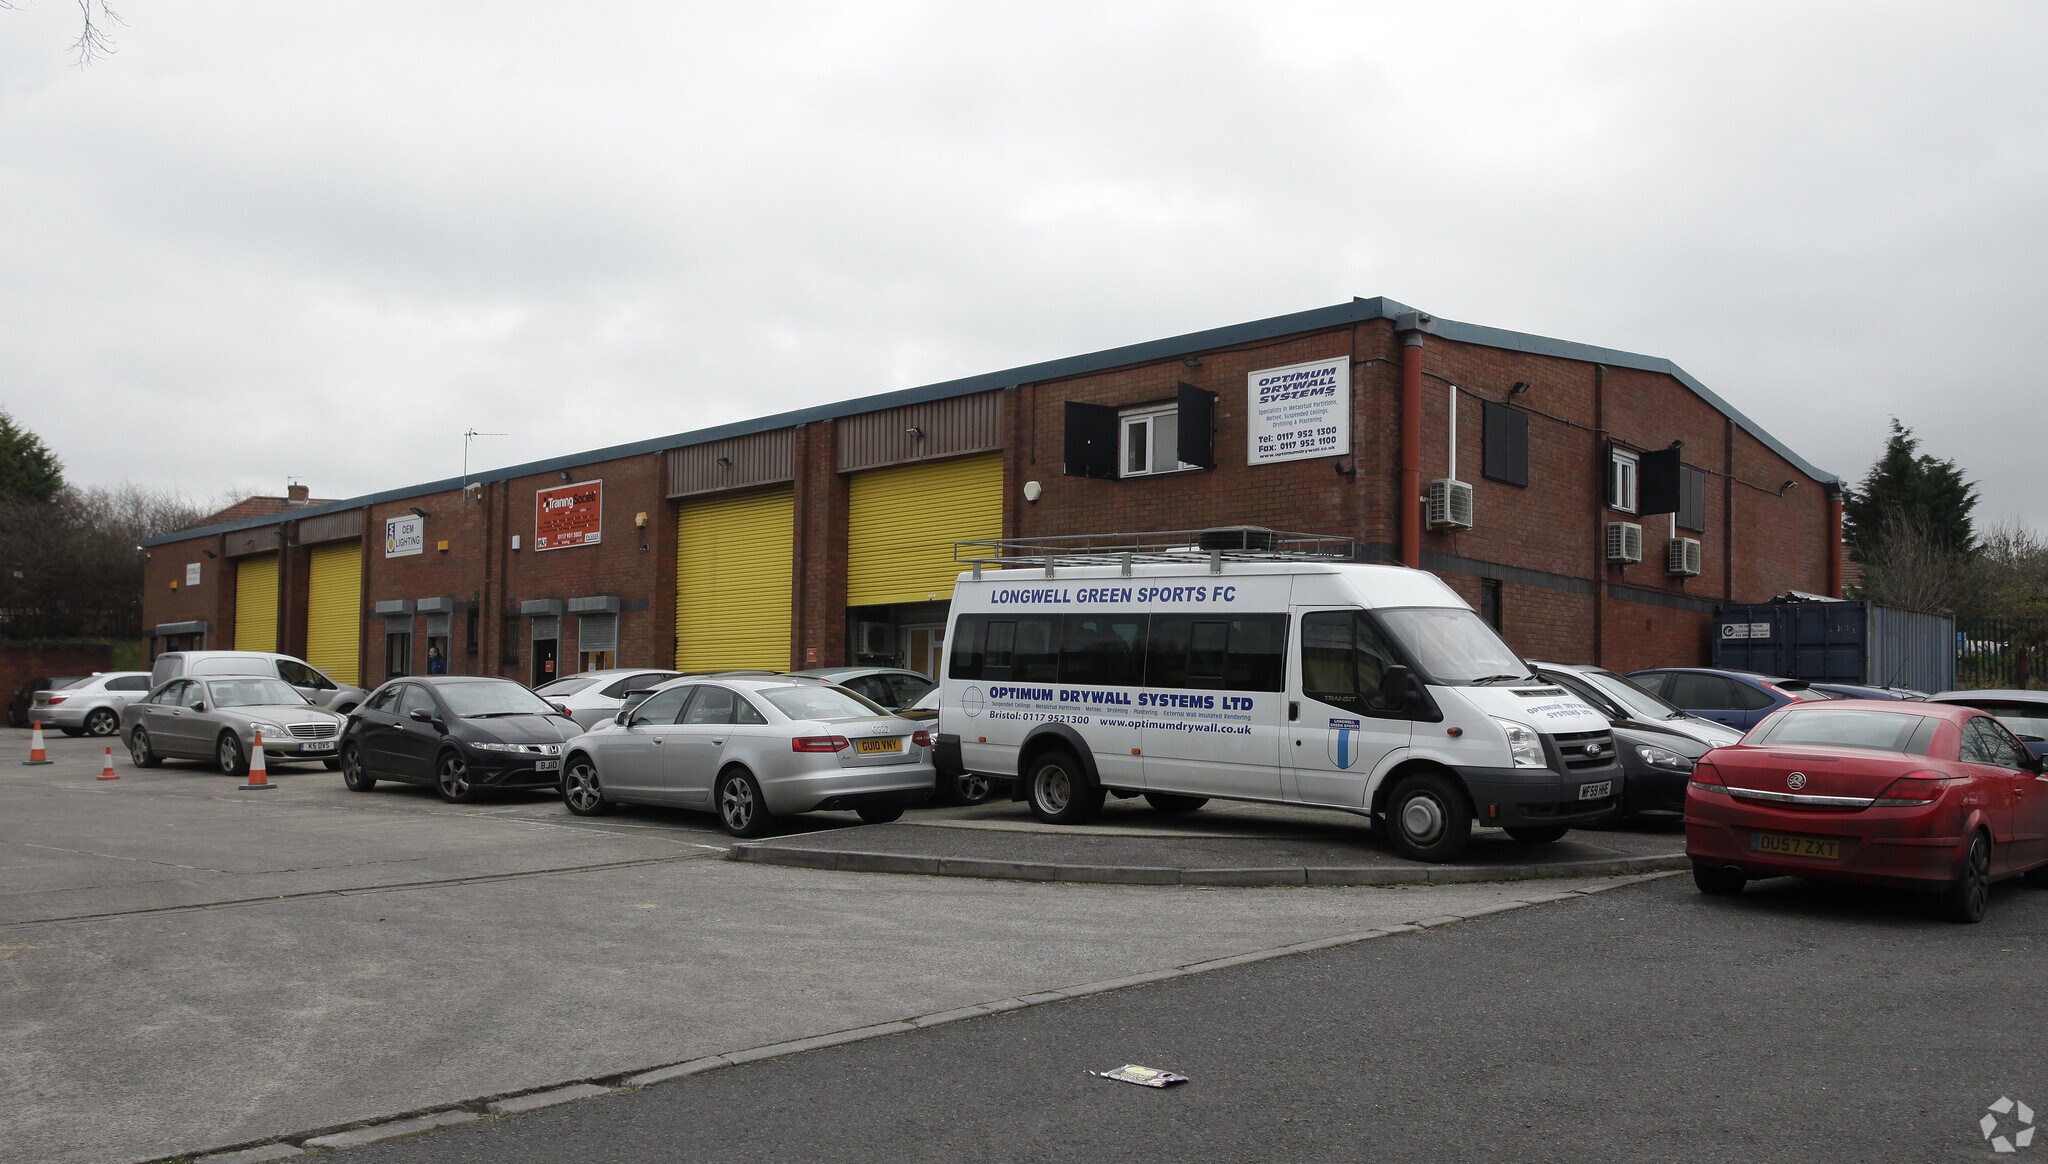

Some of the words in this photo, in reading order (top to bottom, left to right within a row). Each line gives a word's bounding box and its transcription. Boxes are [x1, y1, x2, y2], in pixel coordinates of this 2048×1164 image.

[1258, 367, 1337, 386] OPTIMUM
[1259, 377, 1336, 395] DRYWALL
[1258, 386, 1336, 404] SYSTEMS
[1258, 406, 1282, 416] Specialists
[1284, 410, 1309, 419] Suspended
[1299, 416, 1322, 424] Plastering
[1258, 434, 1274, 443] Tel:
[1276, 432, 1294, 441] 0117
[1297, 429, 1313, 439] 952
[1316, 426, 1337, 435] 1300
[1258, 444, 1277, 453] Fax:
[1280, 441, 1297, 450] 0117
[1300, 439, 1315, 448] 952
[1318, 436, 1337, 445] 1100
[1259, 446, 1336, 458] www.optimumdrywall.co.uk
[402, 524, 414, 535] OEM
[395, 535, 420, 548] LIGHTING
[991, 588, 1071, 604] LONGWELL
[1076, 587, 1132, 603] GREEN
[1137, 586, 1207, 603] SPORTS
[1212, 586, 1236, 602] FC
[989, 686, 1053, 701] OPTIMUM
[1060, 689, 1131, 705] DRYWALL
[1138, 692, 1215, 710] SYSTEMS
[1222, 696, 1254, 711] LTD
[1106, 707, 1128, 715] Drylining
[1133, 708, 1158, 716] Plastering
[1526, 703, 1562, 714] OPTIMUM
[1546, 709, 1581, 719] SYSTEMS
[989, 710, 1021, 720] Bristol:
[1022, 712, 1045, 722] 0117
[1047, 714, 1090, 725] 9521300
[1100, 718, 1252, 735] www.optimumdrywall.co.uk
[862, 741, 880, 751] GU10
[881, 739, 897, 750] VNY
[541, 761, 557, 769] BJ10
[1582, 785, 1598, 798] WF59
[1805, 840, 1836, 856] ZXT
